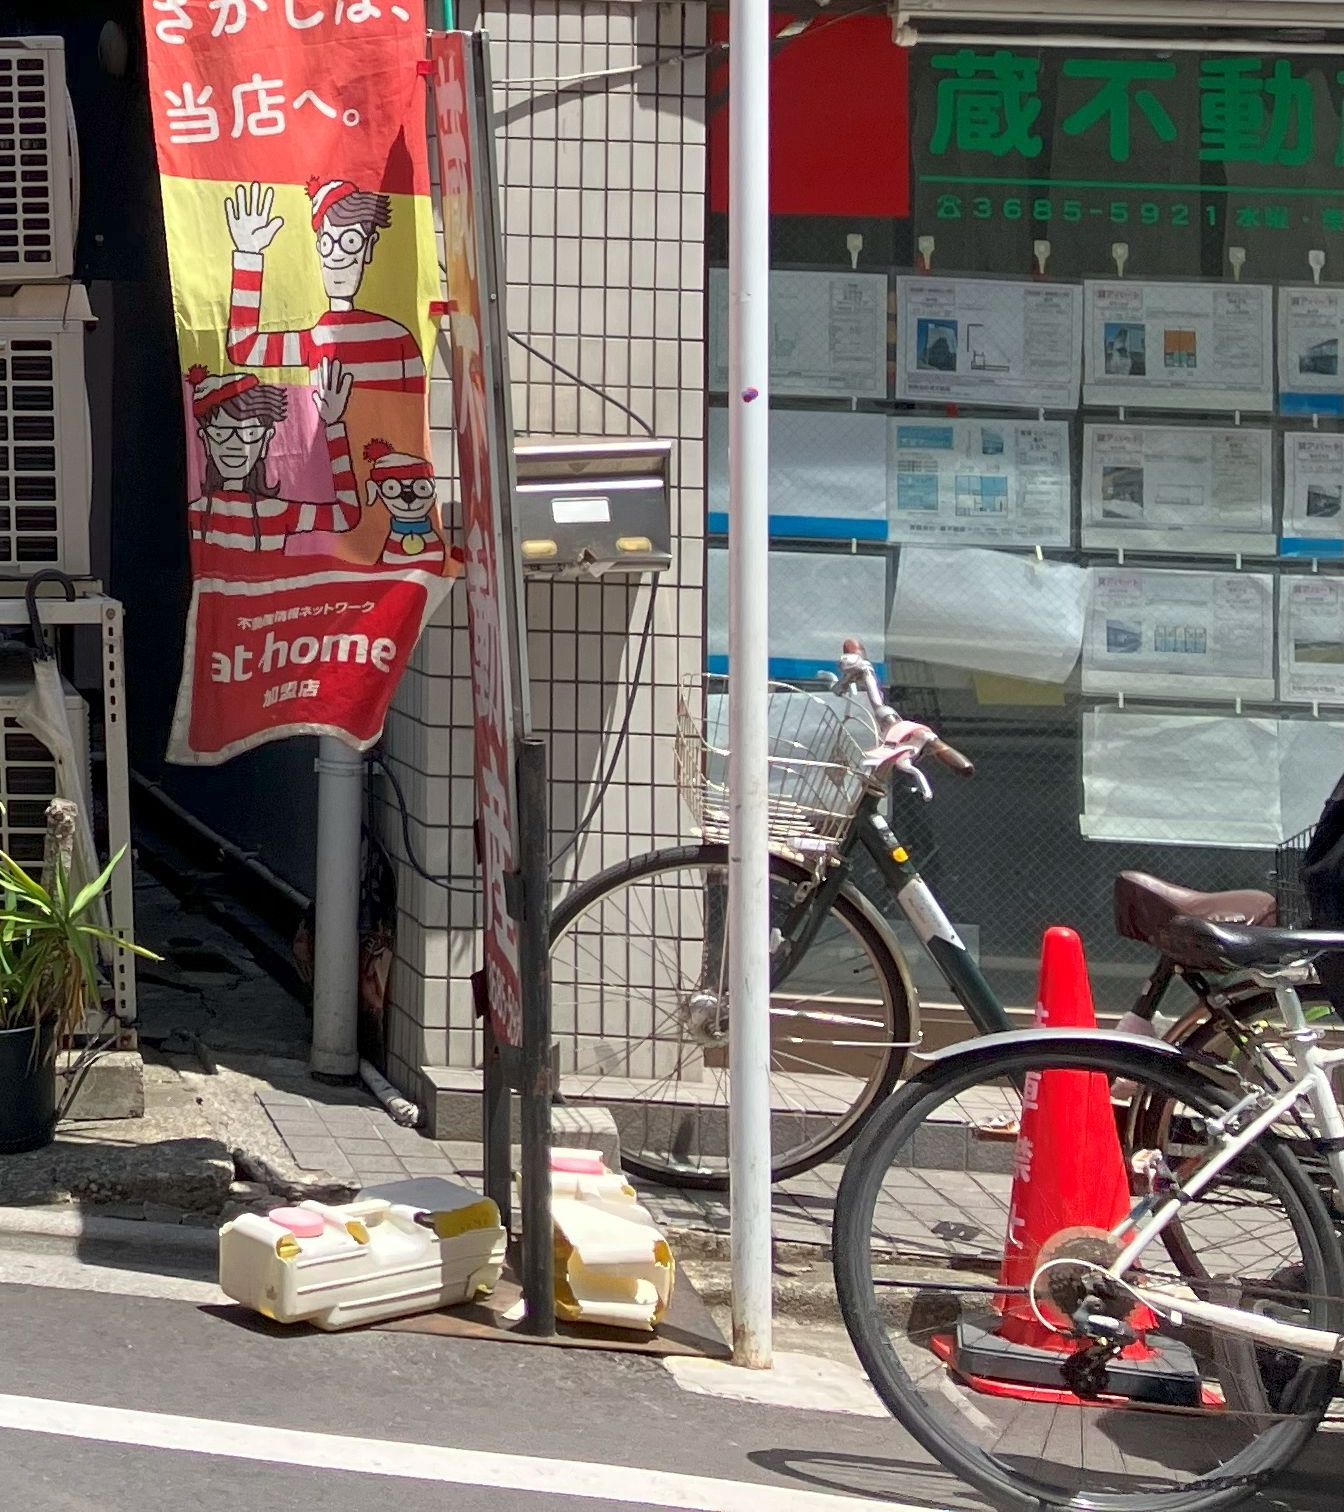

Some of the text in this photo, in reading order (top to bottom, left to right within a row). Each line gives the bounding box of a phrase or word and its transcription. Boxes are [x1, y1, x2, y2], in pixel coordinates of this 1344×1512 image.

[163, 72, 361, 145] 当店へ。
[930, 48, 1344, 168] 蔵不動
[972, 196, 1218, 227] 3685-5921
[211, 631, 397, 684] at home
[262, 678, 321, 709] 加盟店
